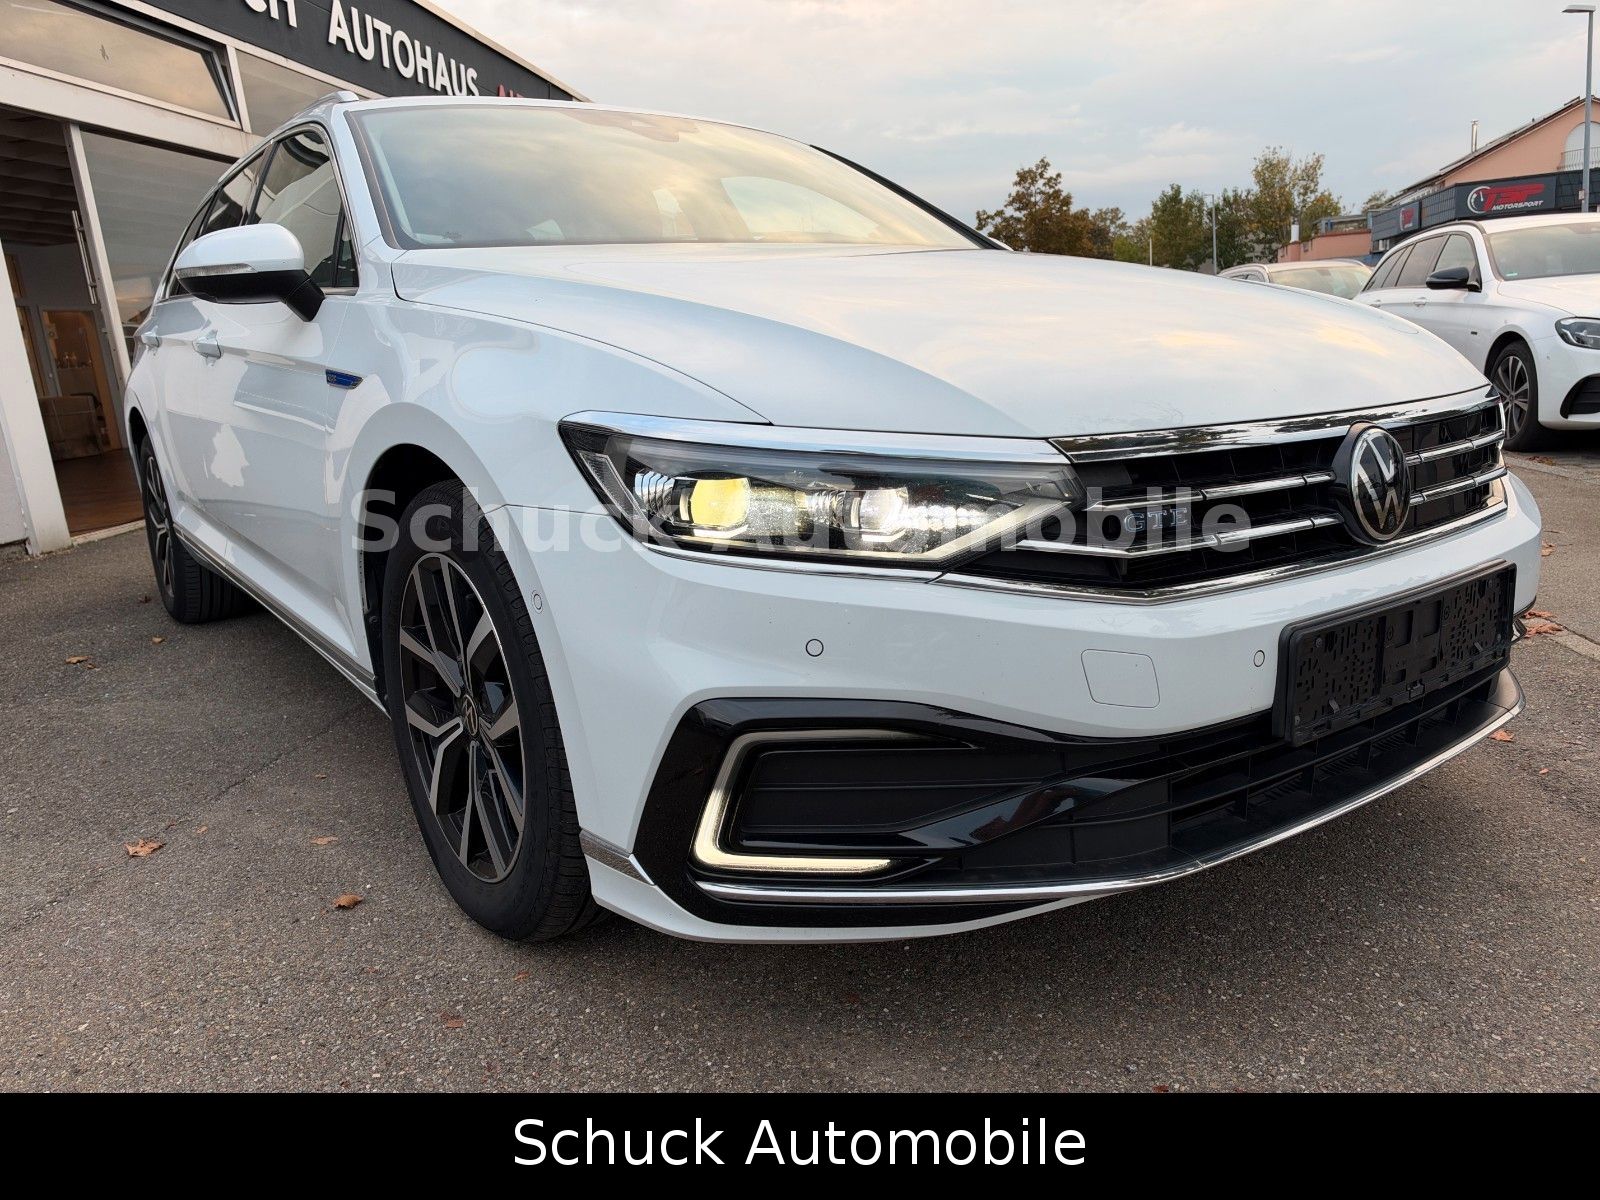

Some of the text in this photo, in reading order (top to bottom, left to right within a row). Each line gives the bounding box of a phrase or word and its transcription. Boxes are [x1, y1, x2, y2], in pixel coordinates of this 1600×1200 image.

[328, 0, 480, 97] AUTOHAUS
[1491, 200, 1544, 211] MOTORSPORT
[1124, 507, 1187, 532] GTE
